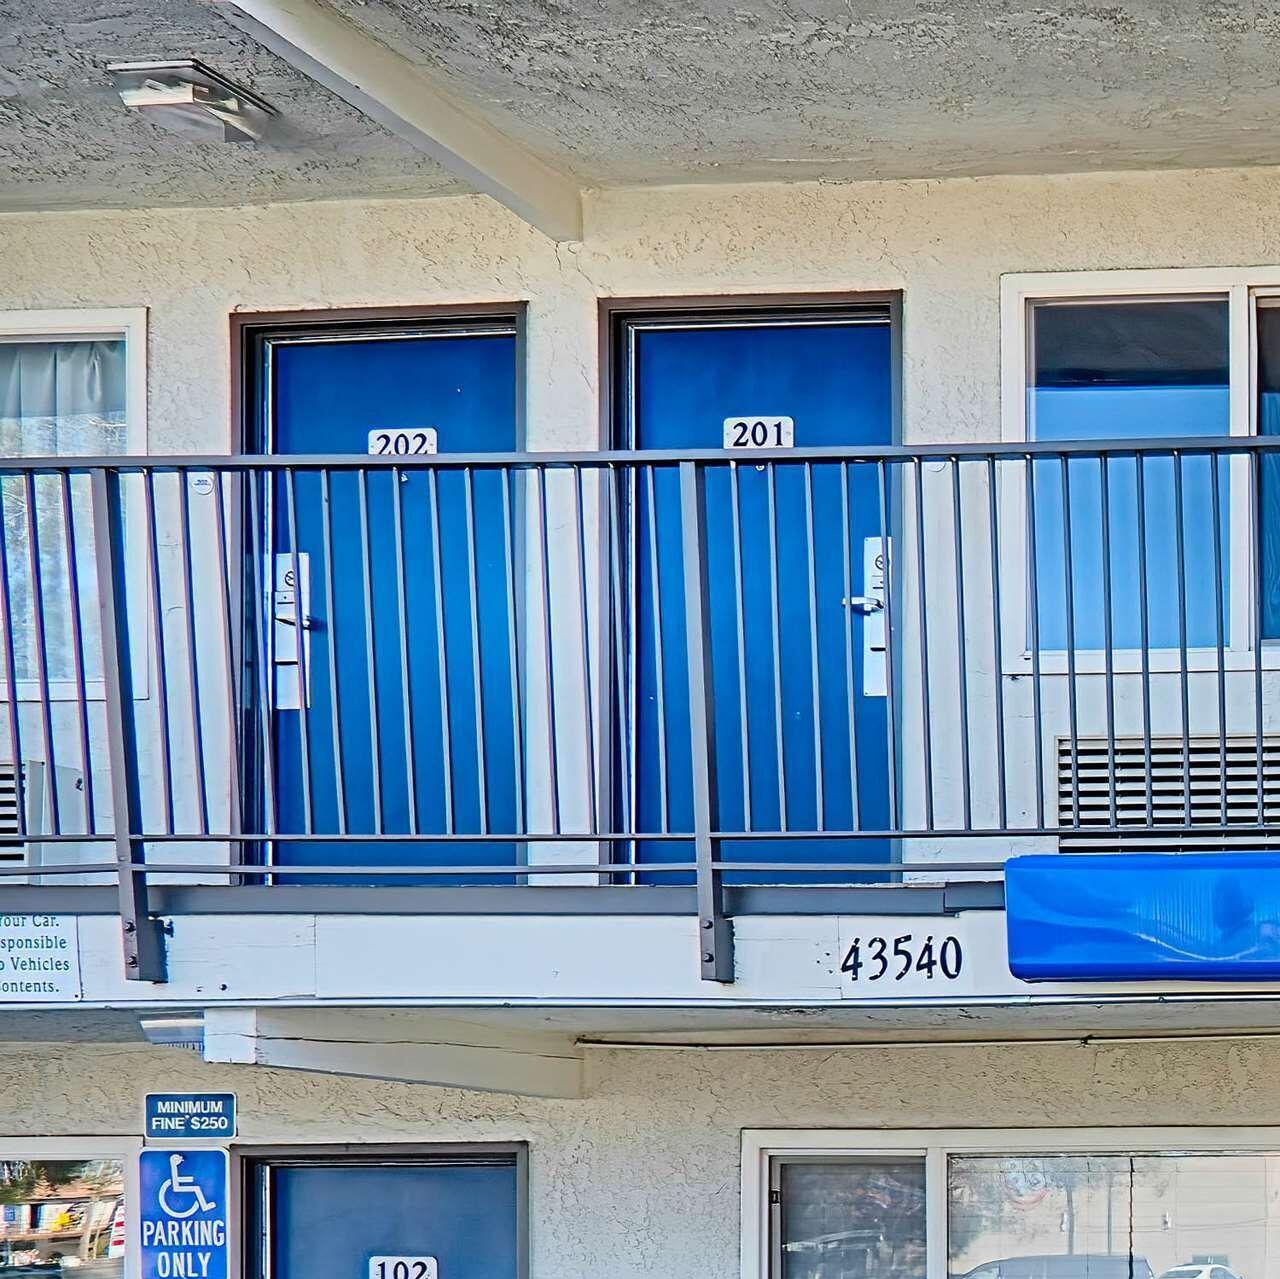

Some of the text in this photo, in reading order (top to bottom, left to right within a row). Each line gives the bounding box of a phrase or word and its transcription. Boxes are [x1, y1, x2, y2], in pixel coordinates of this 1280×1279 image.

[376, 433, 428, 455] 202
[733, 421, 784, 447] 201
[0, 914, 60, 927] our Car.
[10, 957, 70, 971] Vehicles
[840, 934, 963, 981] 43540
[157, 1101, 223, 1114] MINIMUM
[152, 1116, 228, 1130] FINE $250
[143, 1220, 225, 1247] PARKING
[157, 1251, 212, 1278] ONLY
